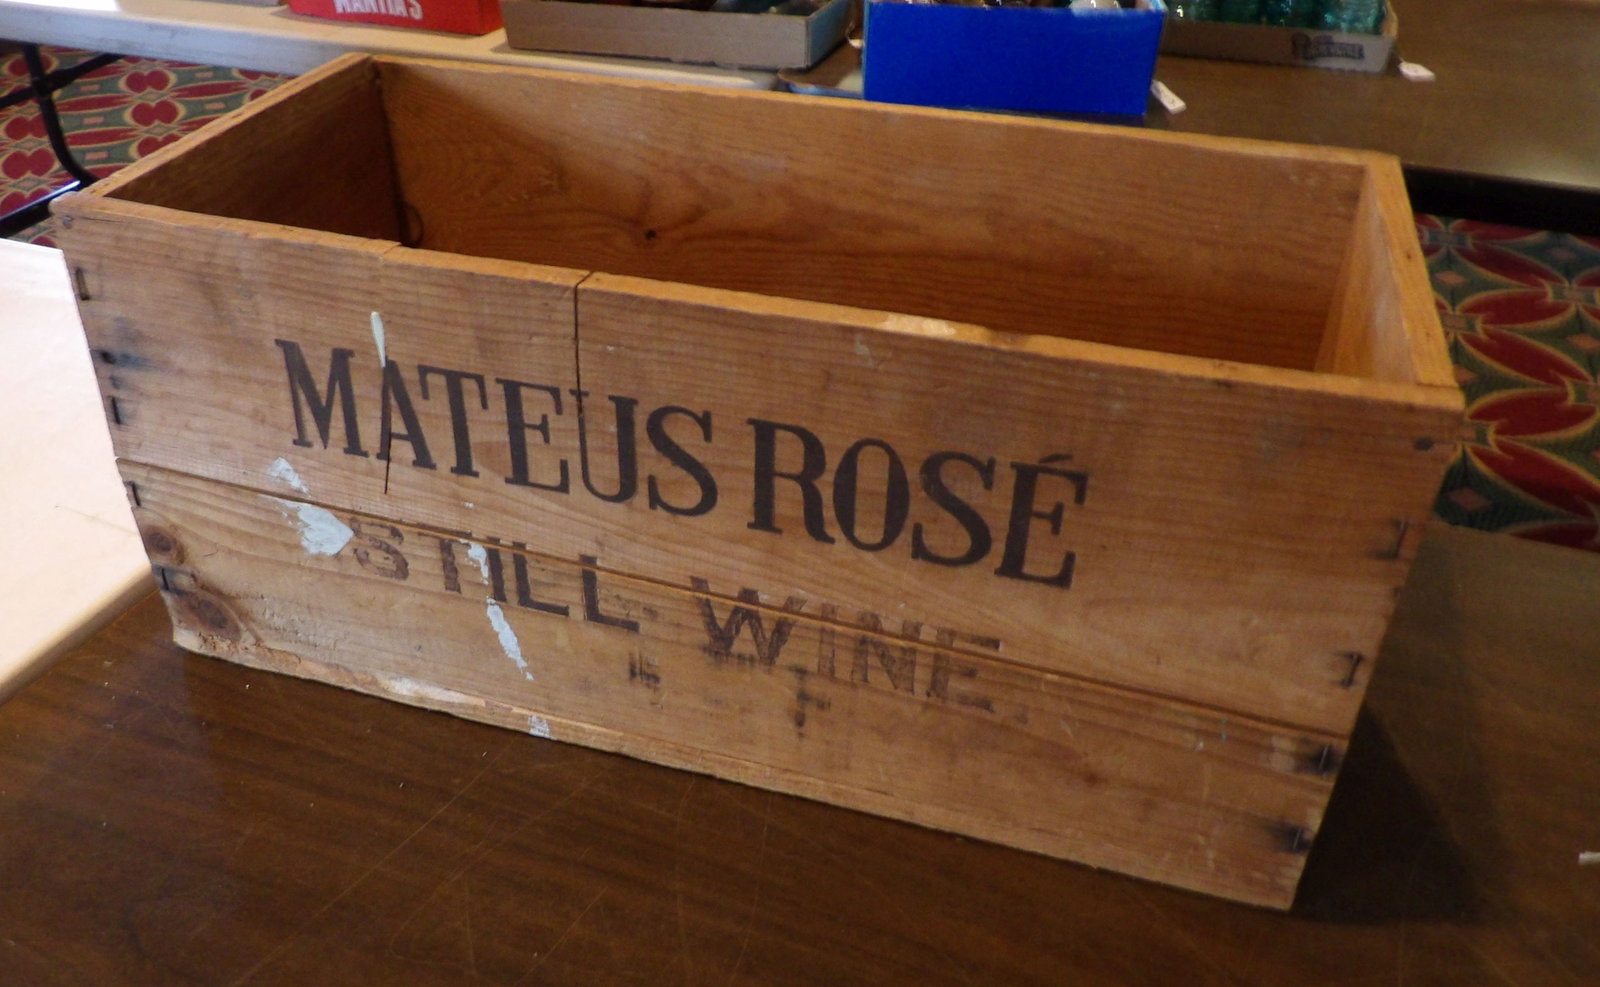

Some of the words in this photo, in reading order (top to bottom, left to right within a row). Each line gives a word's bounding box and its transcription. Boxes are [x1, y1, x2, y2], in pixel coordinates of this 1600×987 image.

[275, 338, 718, 517] MATEUS
[746, 417, 1089, 590] ROSÉ
[351, 516, 640, 633] STILL
[690, 576, 1001, 713] WINE
